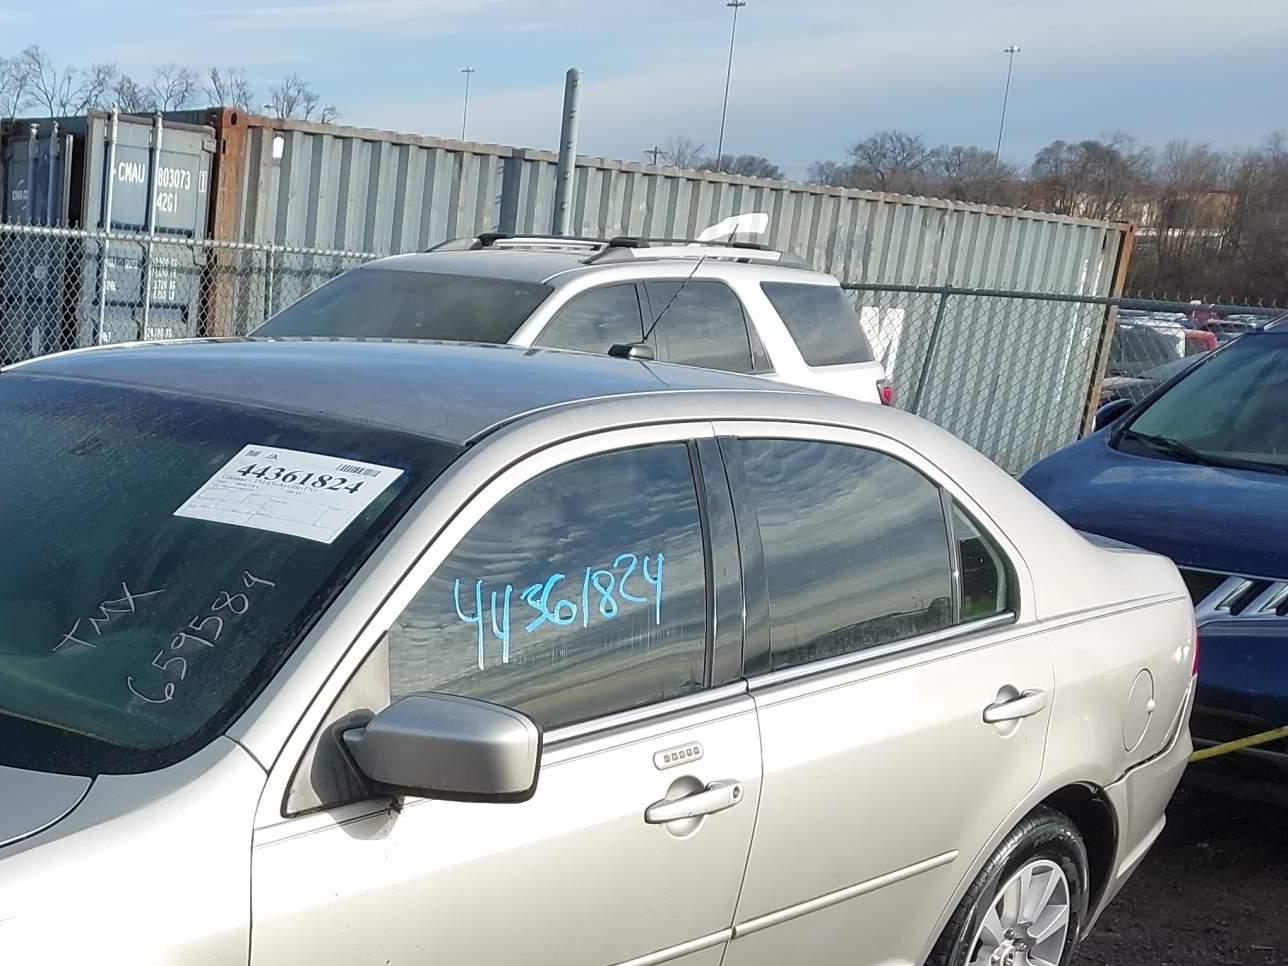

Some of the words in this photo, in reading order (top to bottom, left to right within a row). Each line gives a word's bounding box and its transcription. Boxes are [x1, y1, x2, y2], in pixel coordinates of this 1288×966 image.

[118, 161, 146, 183] CMAU
[157, 167, 191, 190] 803073
[236, 462, 365, 494] 44361824
[453, 552, 665, 670] 44361824
